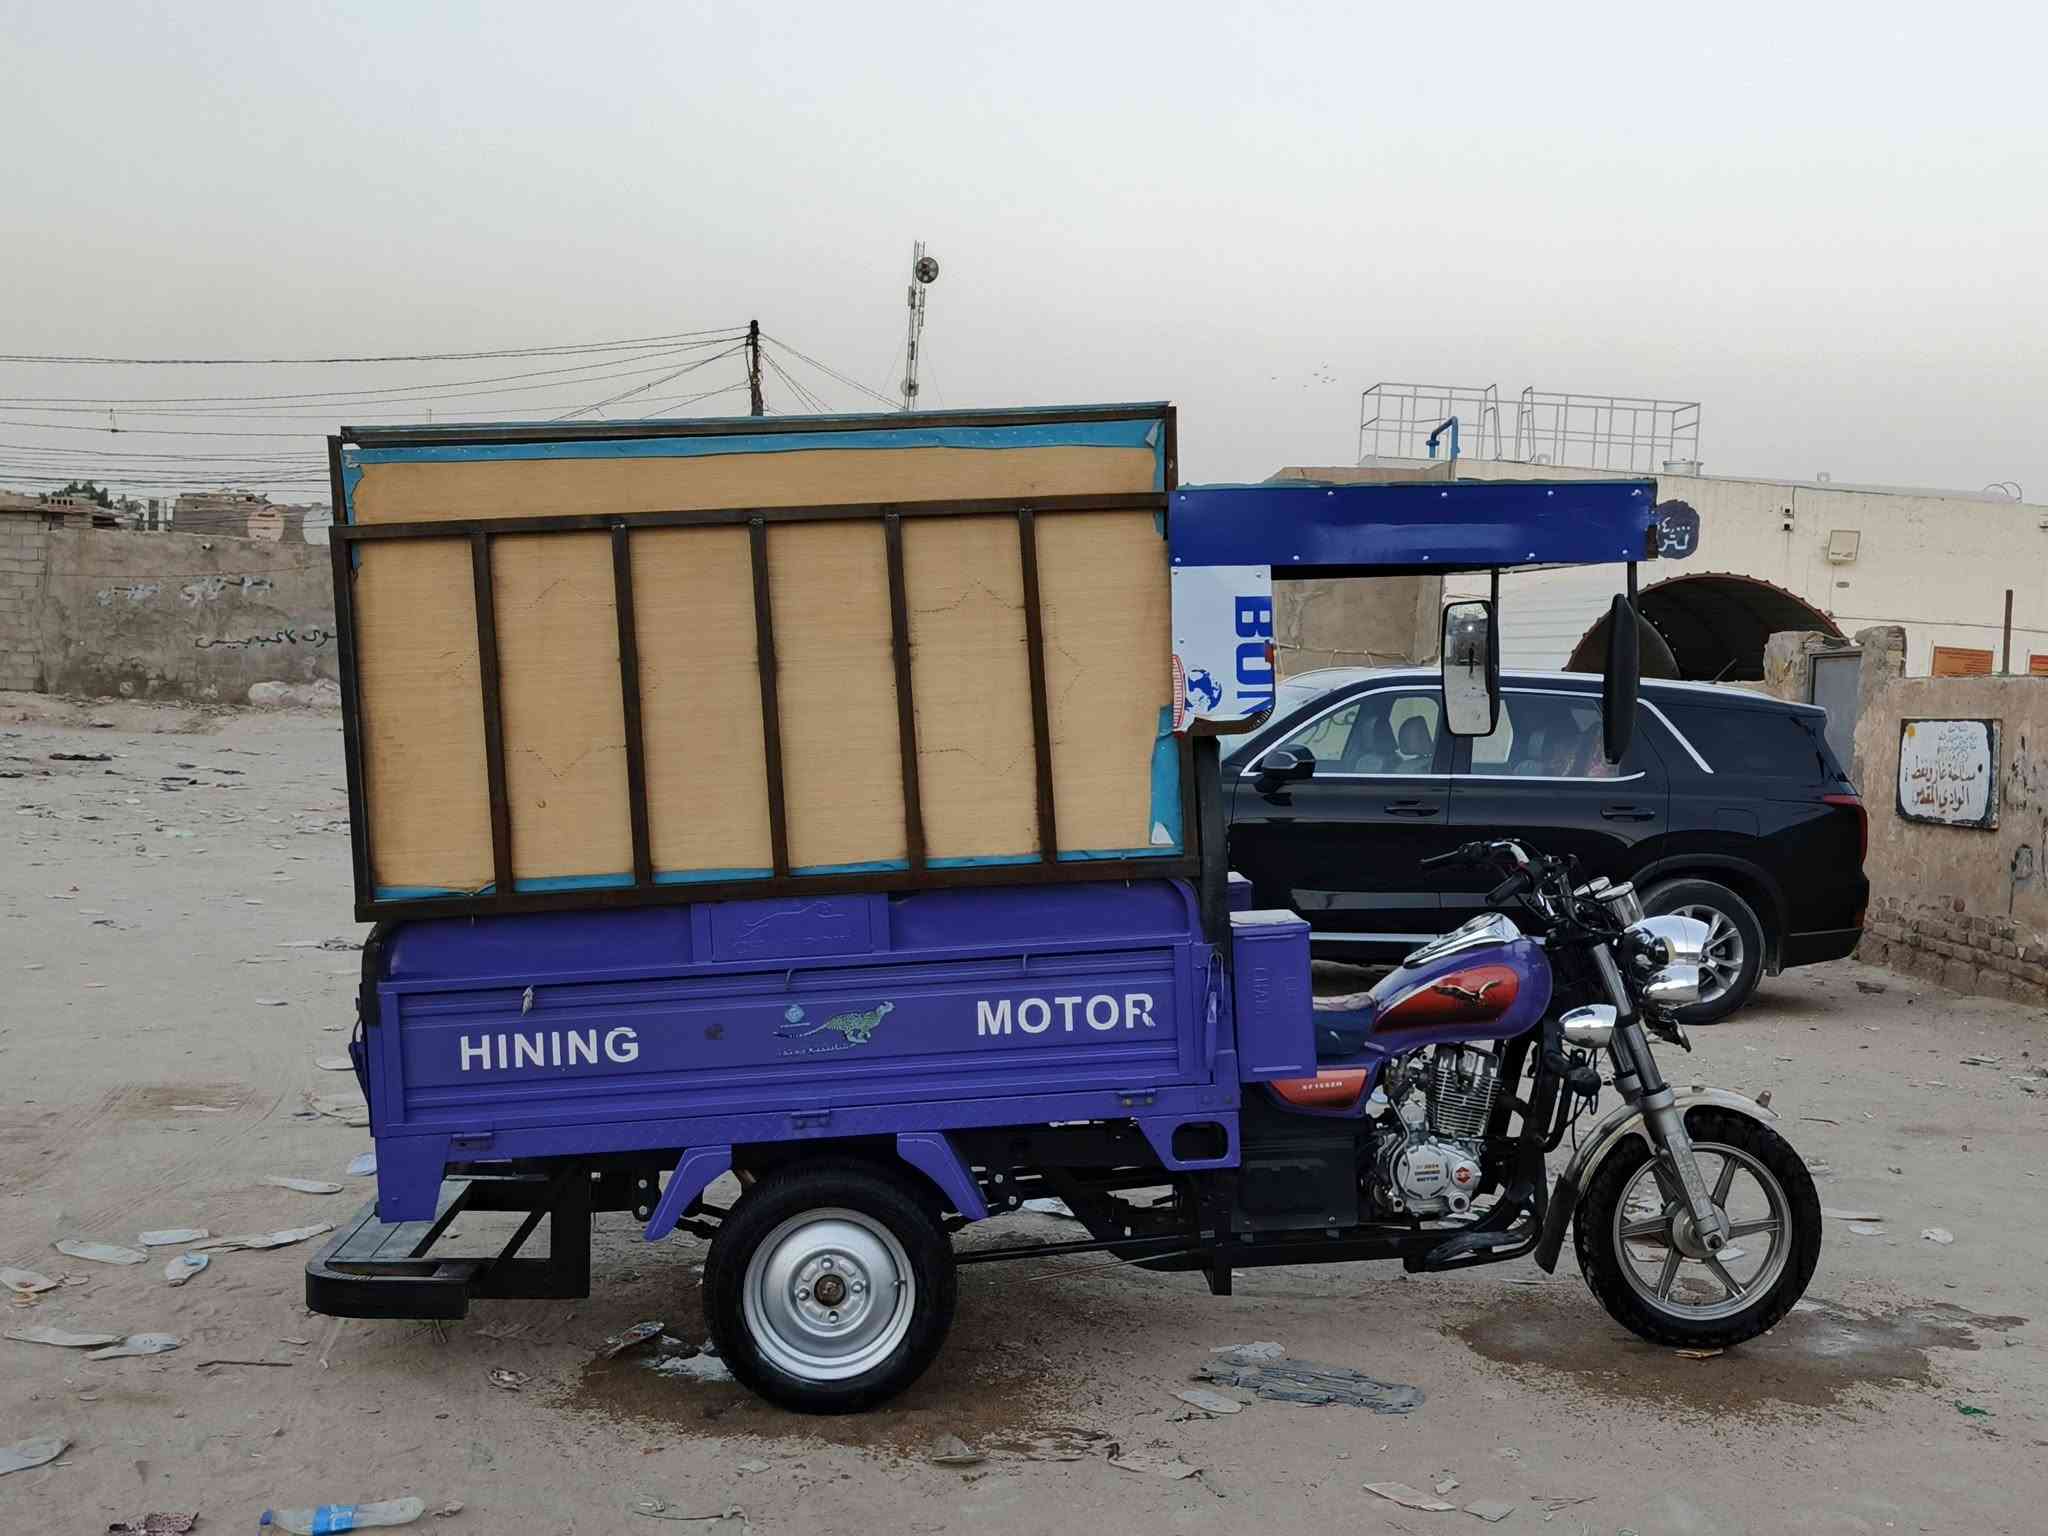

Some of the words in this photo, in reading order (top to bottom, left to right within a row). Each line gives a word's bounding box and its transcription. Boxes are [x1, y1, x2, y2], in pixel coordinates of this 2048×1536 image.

[1938, 785, 1970, 815] الوادي
[977, 993, 1156, 1036] MOTOR
[460, 1027, 639, 1071] HINING
